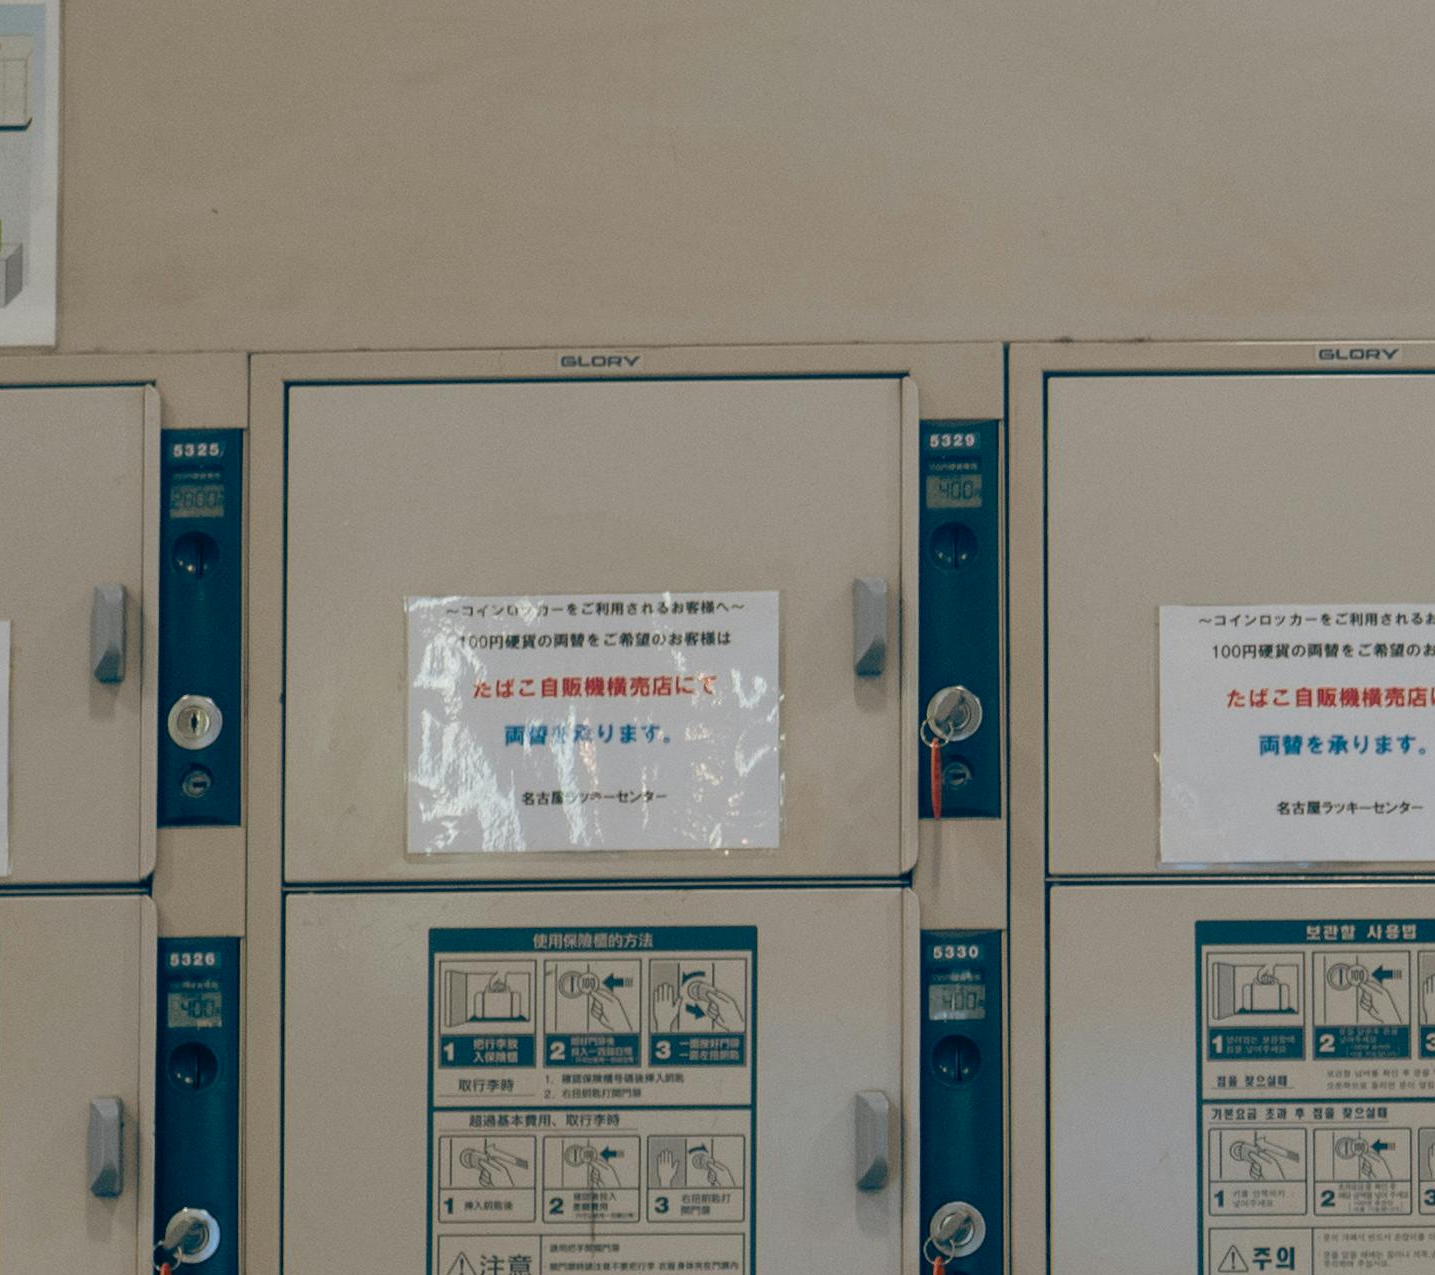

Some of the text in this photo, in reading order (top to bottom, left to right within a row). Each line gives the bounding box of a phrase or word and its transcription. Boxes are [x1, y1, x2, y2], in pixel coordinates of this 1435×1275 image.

[1318, 348, 1399, 360] GLORY
[560, 355, 641, 368] GLORY
[929, 435, 975, 447] 5329
[173, 444, 218, 457] 5325
[1258, 733, 1427, 758] 両替を承ります。
[1276, 799, 1423, 816] 名古屋ラッキーセンター
[532, 932, 653, 949] 使用保險櫃的方法
[933, 946, 978, 959] 5330
[170, 954, 215, 966] 5326
[1252, 1246, 1295, 1271] 주의
